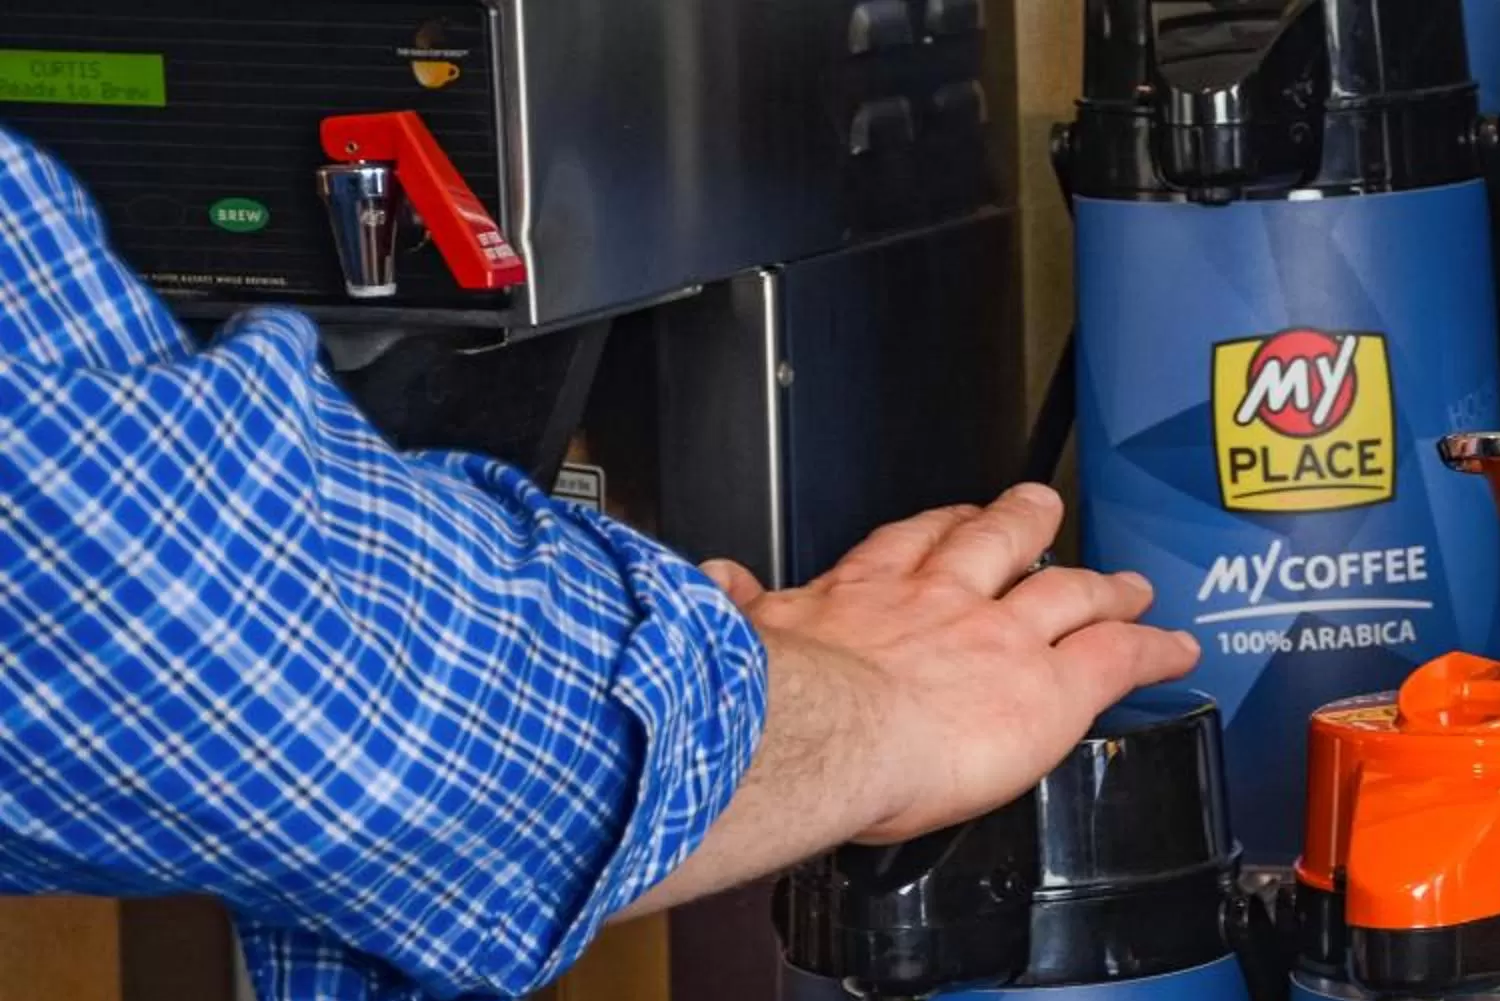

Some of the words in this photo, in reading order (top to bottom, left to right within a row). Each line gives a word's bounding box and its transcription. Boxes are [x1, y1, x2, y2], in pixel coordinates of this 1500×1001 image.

[217, 208, 262, 223] BREW
[1228, 439, 1385, 484] PLACE
[1217, 630, 1292, 655] 100%
[1299, 620, 1417, 651] ARABICA
